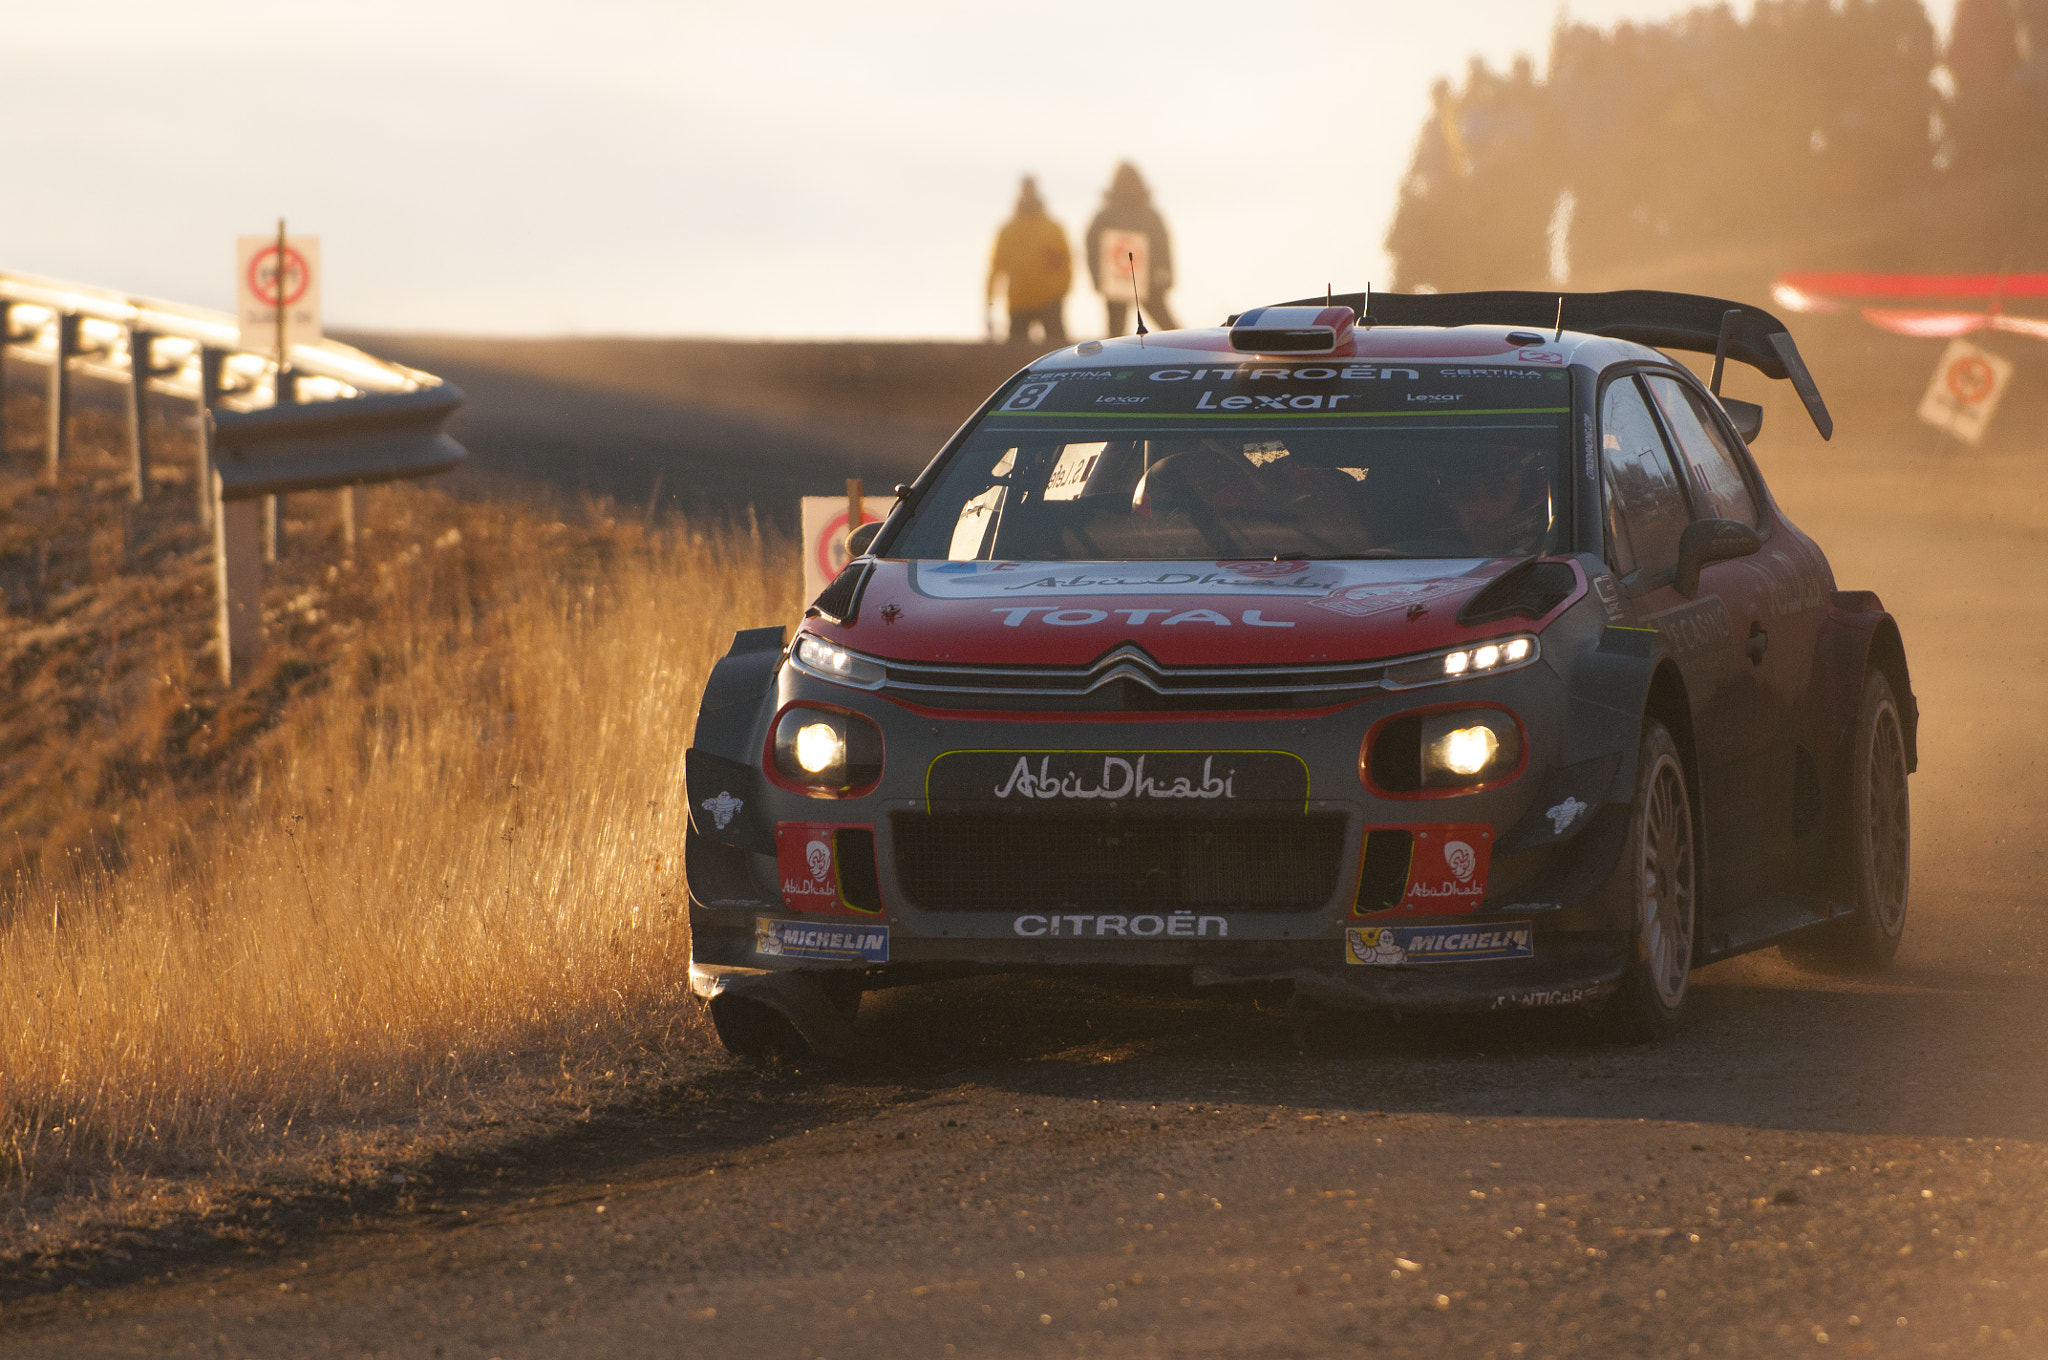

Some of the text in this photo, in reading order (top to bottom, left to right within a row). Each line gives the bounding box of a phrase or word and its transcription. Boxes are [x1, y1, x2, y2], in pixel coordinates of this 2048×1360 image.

[1026, 370, 1112, 380] CERTINA
[1439, 368, 1542, 377] CERTINA
[1095, 394, 1149, 404] Lexar
[1196, 391, 1351, 410] Lexar
[1406, 393, 1463, 401] Lexar
[991, 605, 1296, 628] TOTAL
[783, 929, 884, 950] MICHELIN
[1407, 929, 1529, 951] MICHELIN
